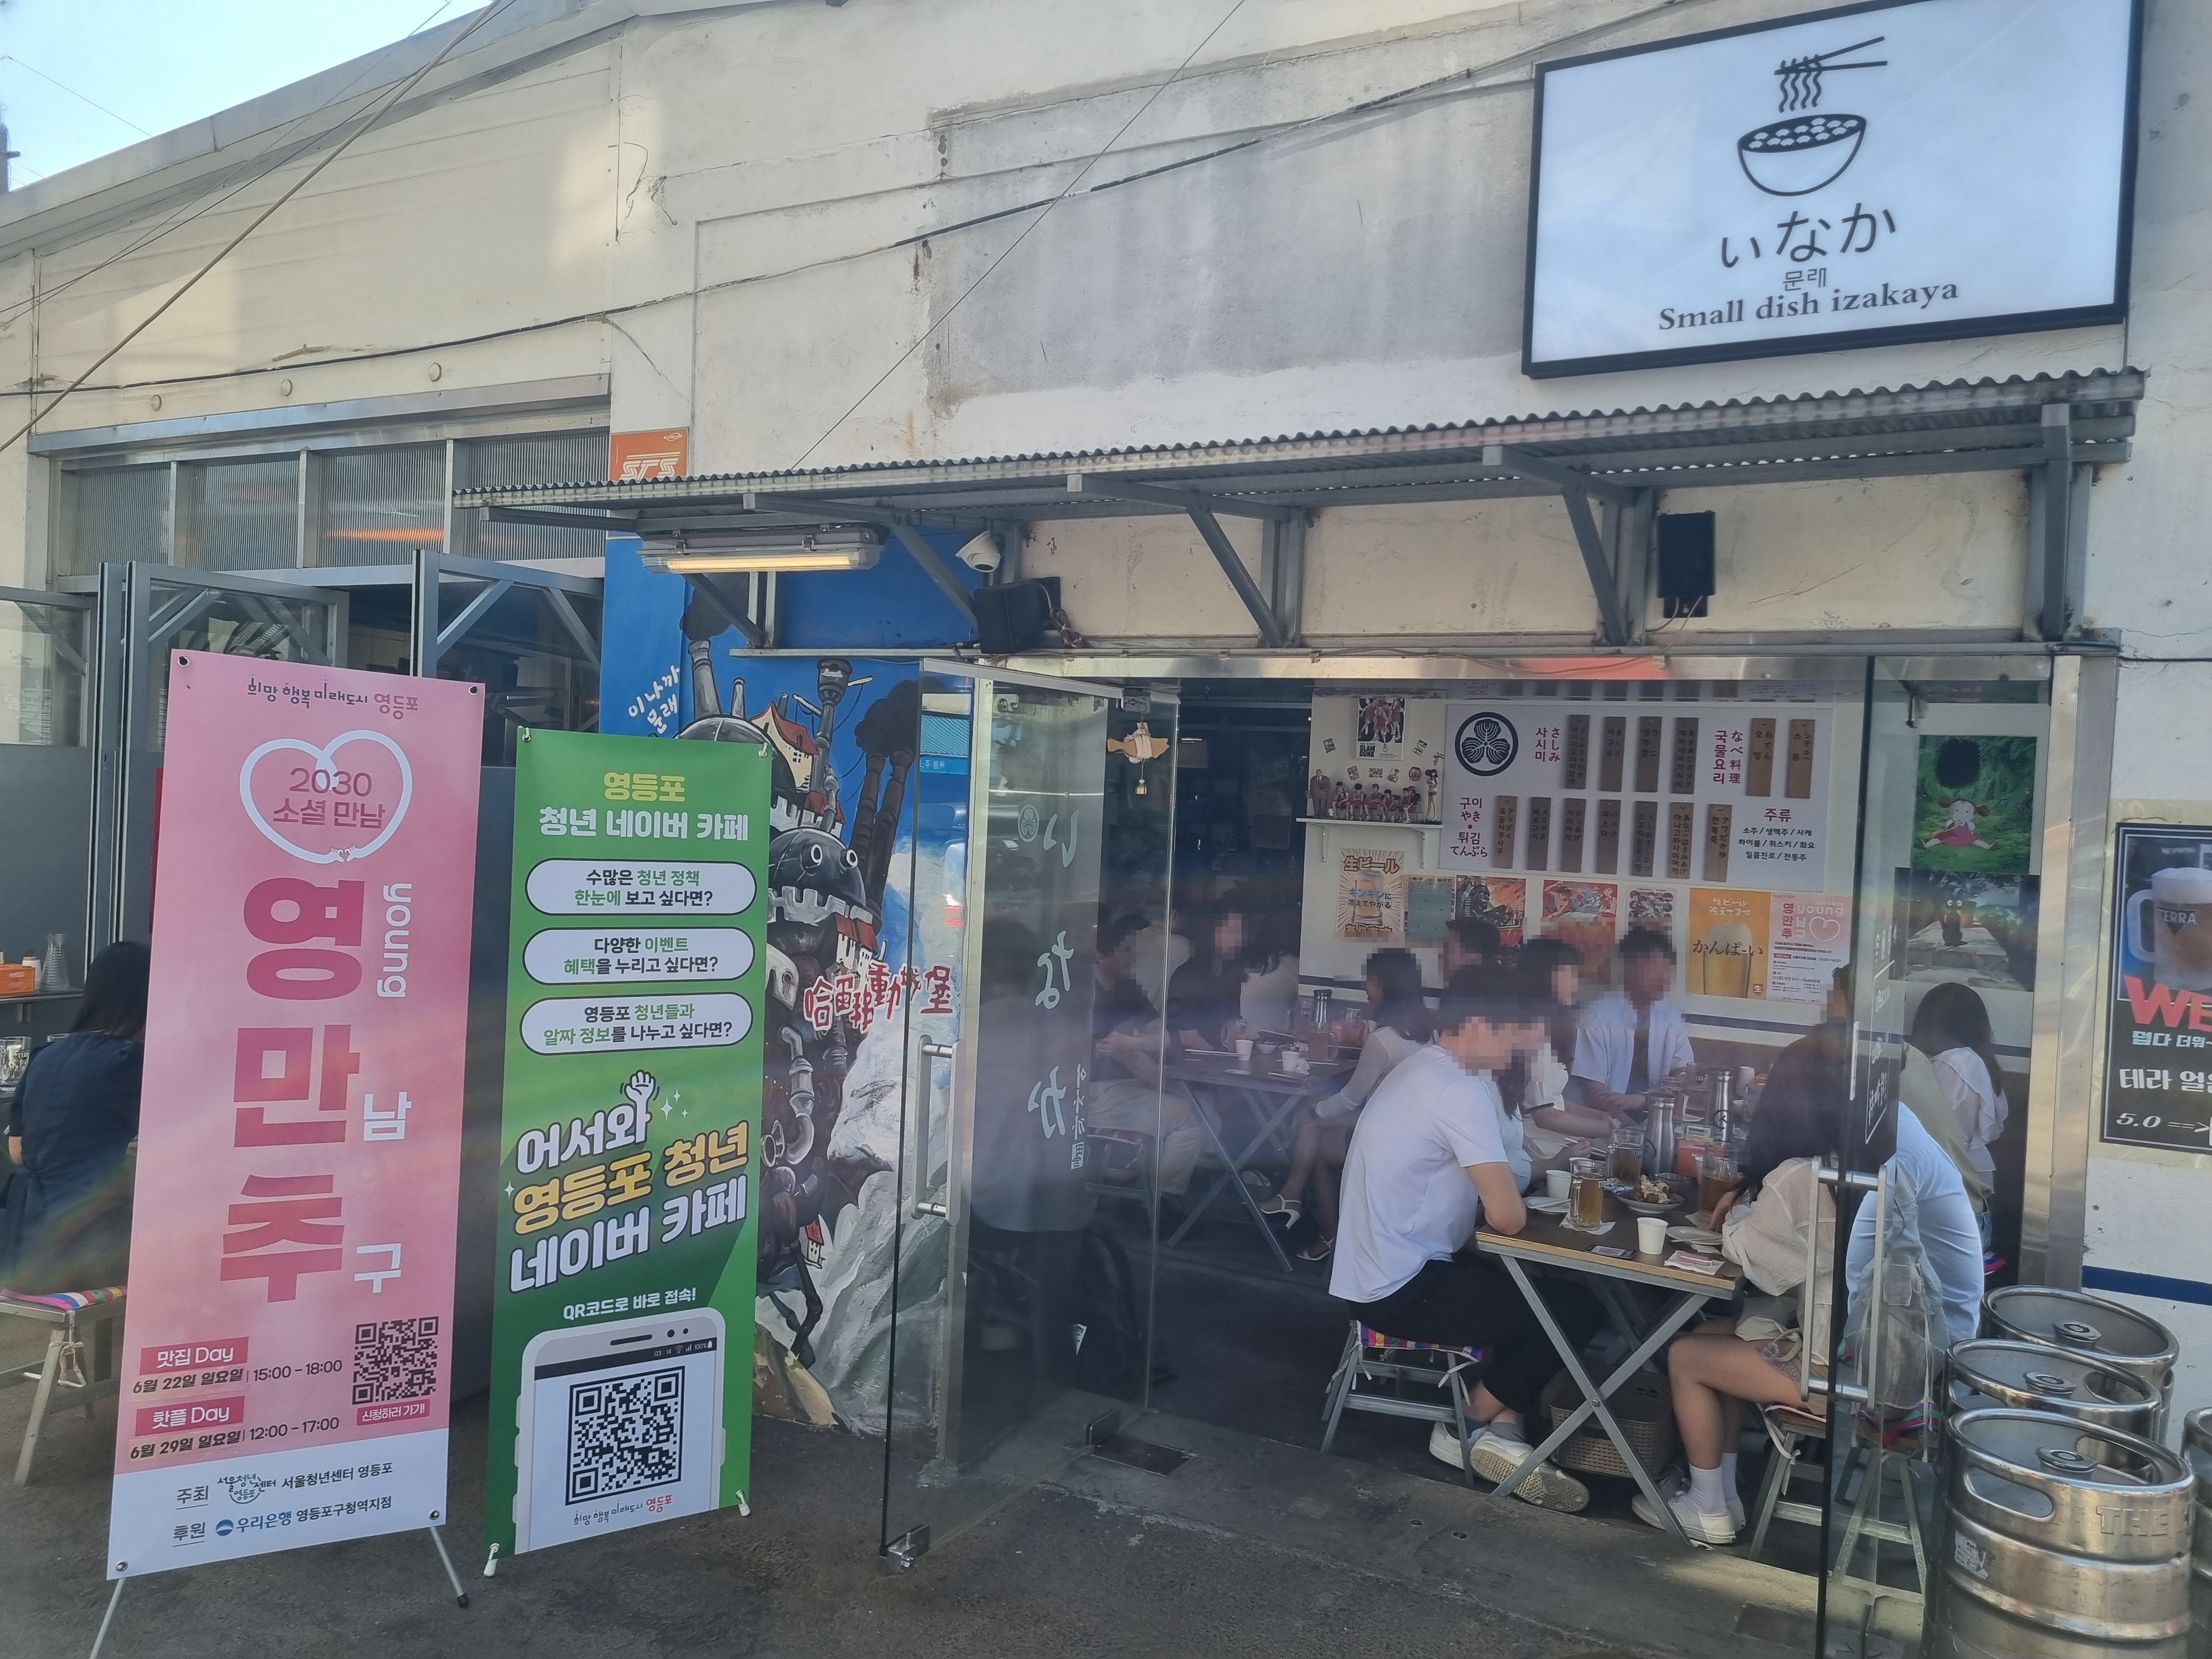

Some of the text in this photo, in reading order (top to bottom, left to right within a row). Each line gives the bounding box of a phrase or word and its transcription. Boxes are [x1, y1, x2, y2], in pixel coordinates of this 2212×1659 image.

[1721, 202, 1896, 268] いなか
[1782, 267, 1827, 292] 문래
[1658, 280, 1959, 331] Small dish izakaya
[618, 458, 679, 480] STS
[247, 674, 418, 720] 희망 행복 미래도시 영등포
[628, 665, 680, 717] 이나까
[647, 693, 678, 734] 문래
[1535, 727, 1548, 762] 사시미
[1548, 727, 1560, 762] さしみ
[1713, 730, 1728, 784] 국물요리
[1729, 730, 1743, 784] なべ料理
[289, 768, 373, 797] 2030
[604, 772, 686, 802] 영등포
[272, 798, 385, 829] 소셜 만남
[1460, 797, 1482, 809] 구이
[1764, 808, 1792, 822] 주류
[539, 807, 749, 841] 청년 네이버 카페
[1460, 810, 1481, 822] やき
[1458, 832, 1480, 845] 튀김
[1738, 839, 1760, 848] 하이볼
[1765, 828, 1788, 836] 생맥주
[1450, 845, 1488, 857] てんぷら
[1344, 855, 1400, 874] 生ビール
[586, 870, 699, 887] 수많은 청년 정책
[574, 889, 713, 907] 한눈에 보고 싶다면?
[1348, 887, 1392, 900] キンキンに
[1797, 904, 1844, 917] young
[2157, 910, 2198, 926] TERRA
[376, 883, 412, 998] young
[594, 937, 689, 954] 다양한 이벤트
[1692, 939, 1763, 957] かんぱーい
[564, 957, 718, 975] 혜택을 누리고 싶다면?
[584, 1003, 695, 1023] 영등포 청년들과
[544, 1022, 732, 1046] 알짜 정보를 나누고 싶다면?
[2119, 1069, 2172, 1090] 테라
[2116, 1112, 2161, 1128] 5.0
[516, 1097, 652, 1174] 어서와
[514, 1120, 748, 1235] 영등포 청년
[509, 1175, 748, 1293] 네이버 카페
[354, 1243, 402, 1294] 구
[563, 1288, 696, 1320] QR코드로 바로 접속!
[157, 1345, 235, 1369] 맛집 Day
[132, 1359, 342, 1395] 6월 22일 일요일 15:00 18:00
[152, 1405, 230, 1430] 핫플 Day
[362, 1403, 425, 1422] 신청하러 가기!
[130, 1417, 340, 1460] 6월 29일 일요일 12:00 17:00
[281, 1462, 393, 1489] 서울청년센터 영등포
[176, 1485, 209, 1504] 주최
[236, 1496, 392, 1533] 우리은행 영등포구청역지점
[573, 1494, 672, 1526] 희망 행복 미래도시 영등포
[173, 1522, 206, 1541] 후원
